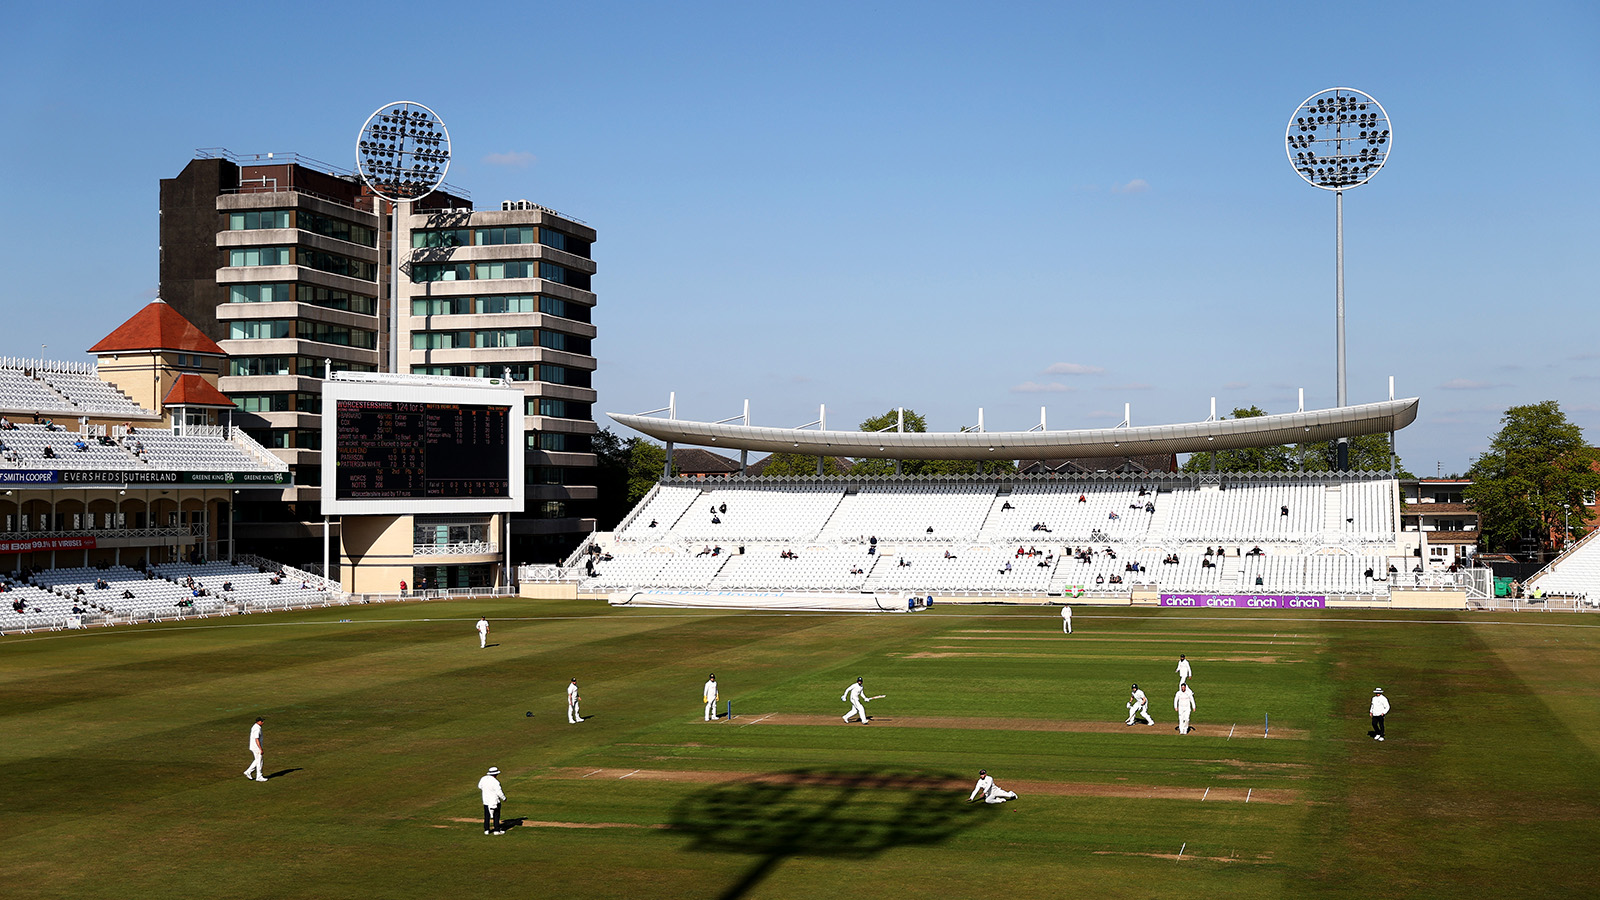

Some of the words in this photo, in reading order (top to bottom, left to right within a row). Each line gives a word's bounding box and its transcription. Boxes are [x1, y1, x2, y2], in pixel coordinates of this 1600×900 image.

[338, 402, 393, 410] WORCESTERSHIRE
[396, 403, 408, 411] 124
[410, 404, 418, 412] for
[420, 405, 424, 413] 5
[4, 473, 24, 481] SMITH
[26, 473, 52, 481] COOPER
[64, 472, 120, 481] EVERSHEDS
[124, 472, 176, 481] SUTHERLAND
[58, 539, 82, 547] VIRUSES
[1166, 595, 1195, 606] cinch
[1206, 596, 1236, 607] cinch
[1247, 596, 1276, 607] cinch
[1289, 597, 1319, 608] cinch
